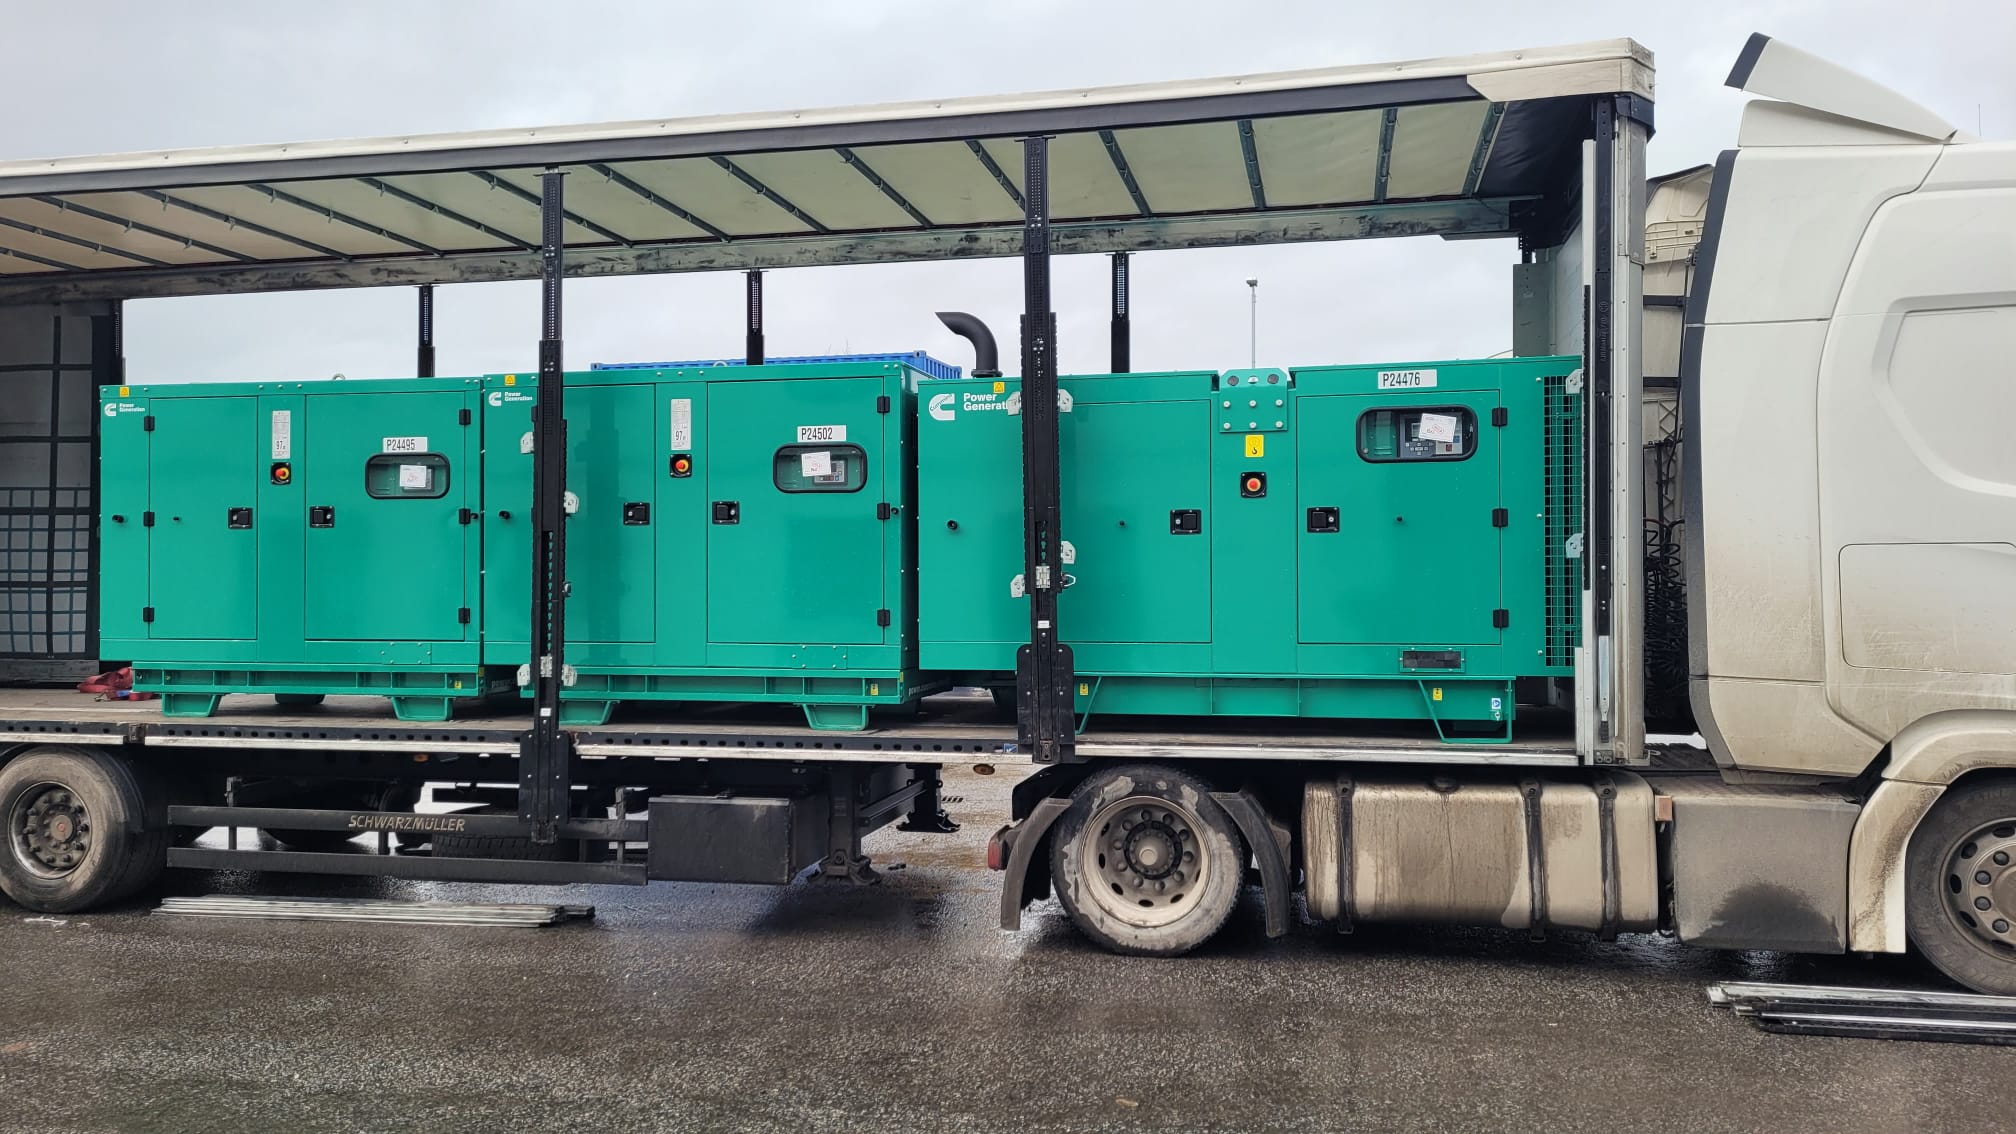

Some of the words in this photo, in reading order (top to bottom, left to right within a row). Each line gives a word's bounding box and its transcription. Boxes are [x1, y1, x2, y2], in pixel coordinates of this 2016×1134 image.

[1382, 371, 1421, 388] P24476
[963, 392, 997, 402] Power
[963, 401, 1006, 411] Generat
[801, 427, 833, 441] P24502
[386, 438, 416, 451] P24495
[348, 815, 466, 832] SCHWARZMÜLLER
